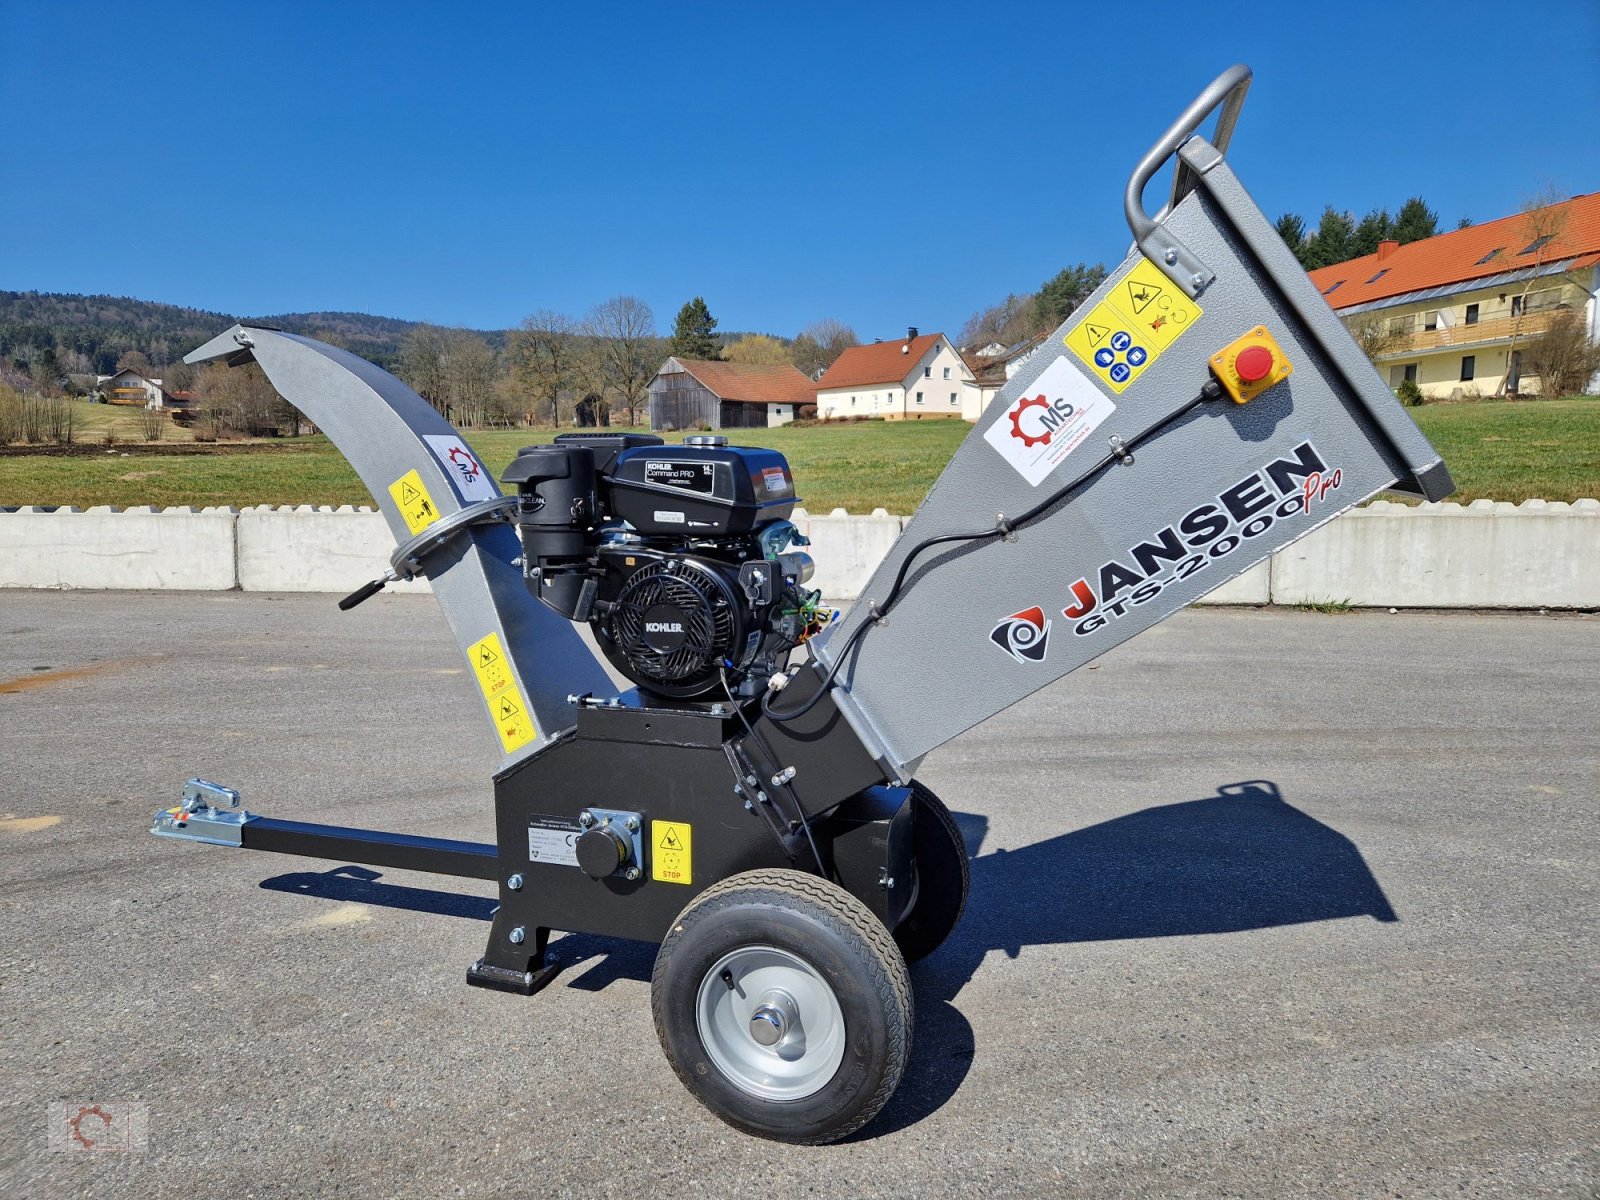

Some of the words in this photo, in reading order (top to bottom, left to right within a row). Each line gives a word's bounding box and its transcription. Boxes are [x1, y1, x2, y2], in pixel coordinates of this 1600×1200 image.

[1039, 398, 1074, 433] MS
[456, 463, 476, 483] MS
[647, 469, 678, 477] Command
[680, 470, 695, 478] PRO
[1063, 441, 1328, 619] JANSEN
[1074, 495, 1305, 635] GTS-2000
[1303, 469, 1341, 514] Pro
[645, 622, 683, 633] KOHLER
[491, 679, 506, 692] STOP
[662, 870, 681, 879] STOP
